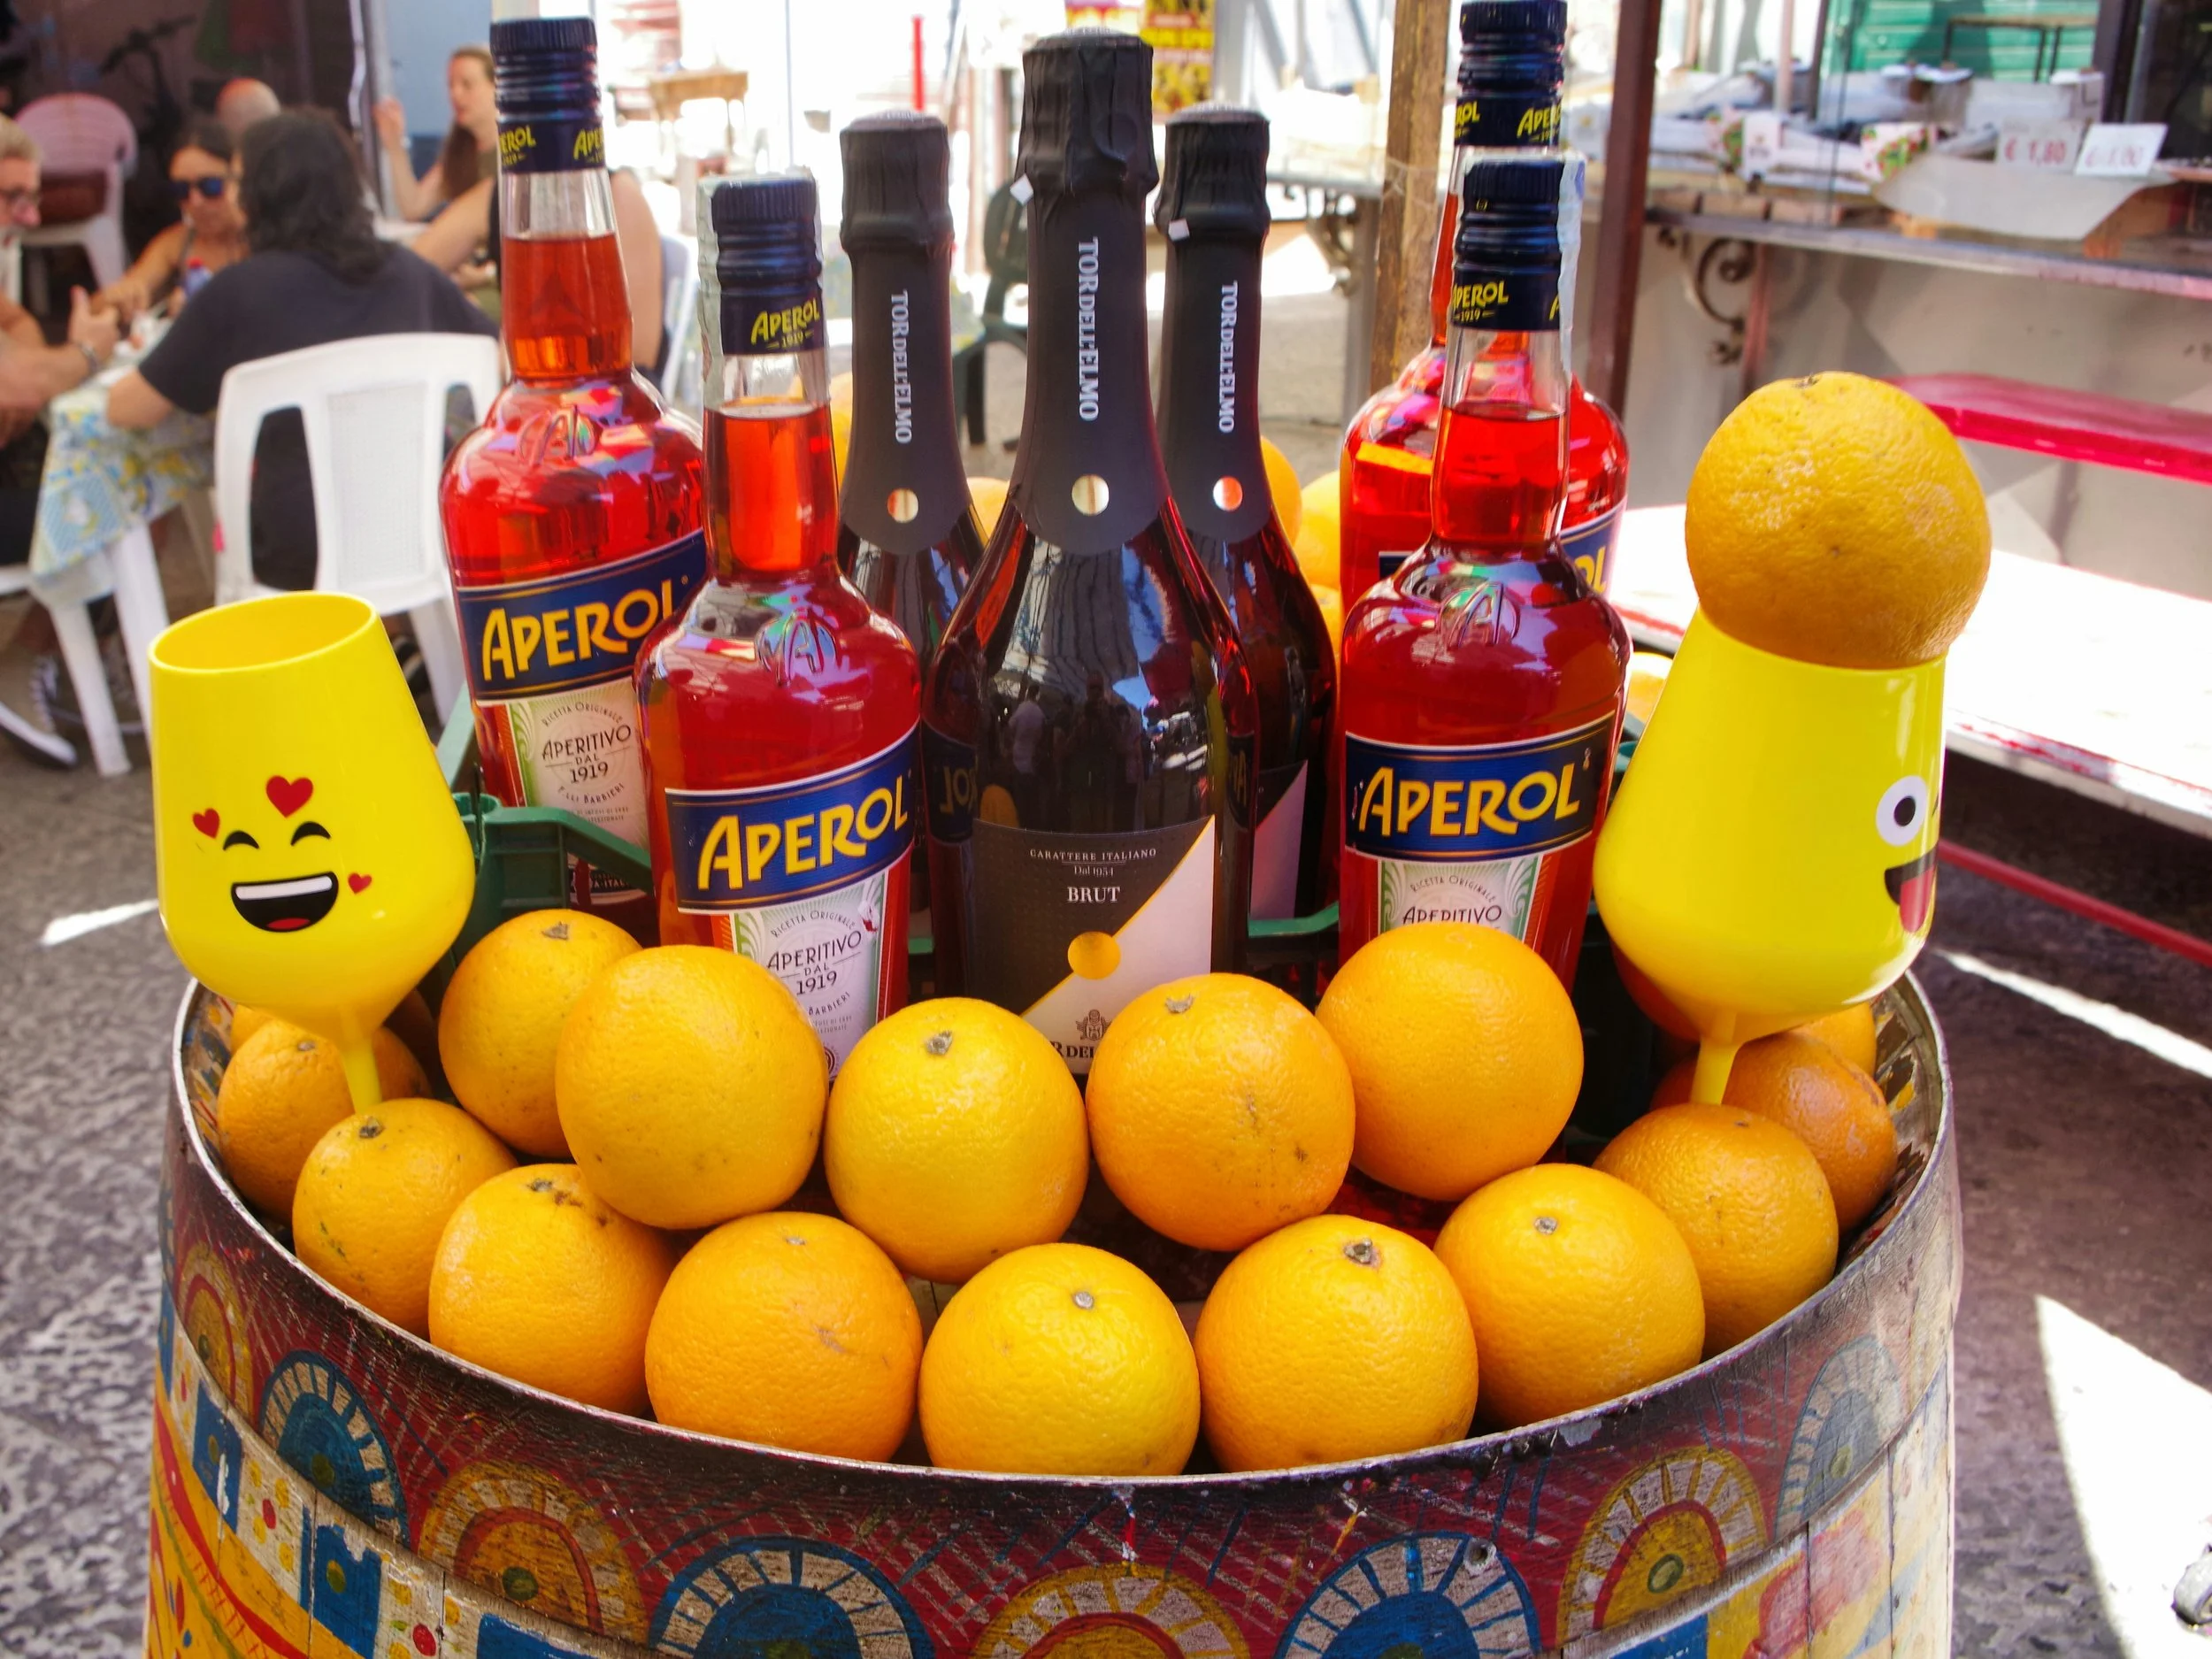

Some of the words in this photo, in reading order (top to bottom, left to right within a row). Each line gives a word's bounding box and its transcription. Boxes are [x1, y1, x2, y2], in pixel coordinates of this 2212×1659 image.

[750, 297, 820, 346] APEROL
[541, 724, 632, 762] APERITIVO
[575, 752, 600, 765] DAL
[571, 761, 609, 784] 1919
[584, 781, 626, 804] BARBIERI
[1358, 762, 1581, 837] APEROL
[697, 773, 908, 891] APEROL
[1029, 849, 1097, 862] CARATTERE
[1102, 848, 1157, 861] ITALIANO
[1066, 886, 1121, 903] BRUT
[1409, 876, 1445, 893] RICETTA
[1448, 874, 1496, 903] ORIGINALE
[771, 914, 806, 939] RICETTA
[810, 910, 856, 931] ORIGINALE
[766, 930, 863, 972] APERITIVO
[796, 970, 837, 996] 1919
[803, 964, 831, 977] DAL
[808, 990, 850, 1016] BARBIERI
